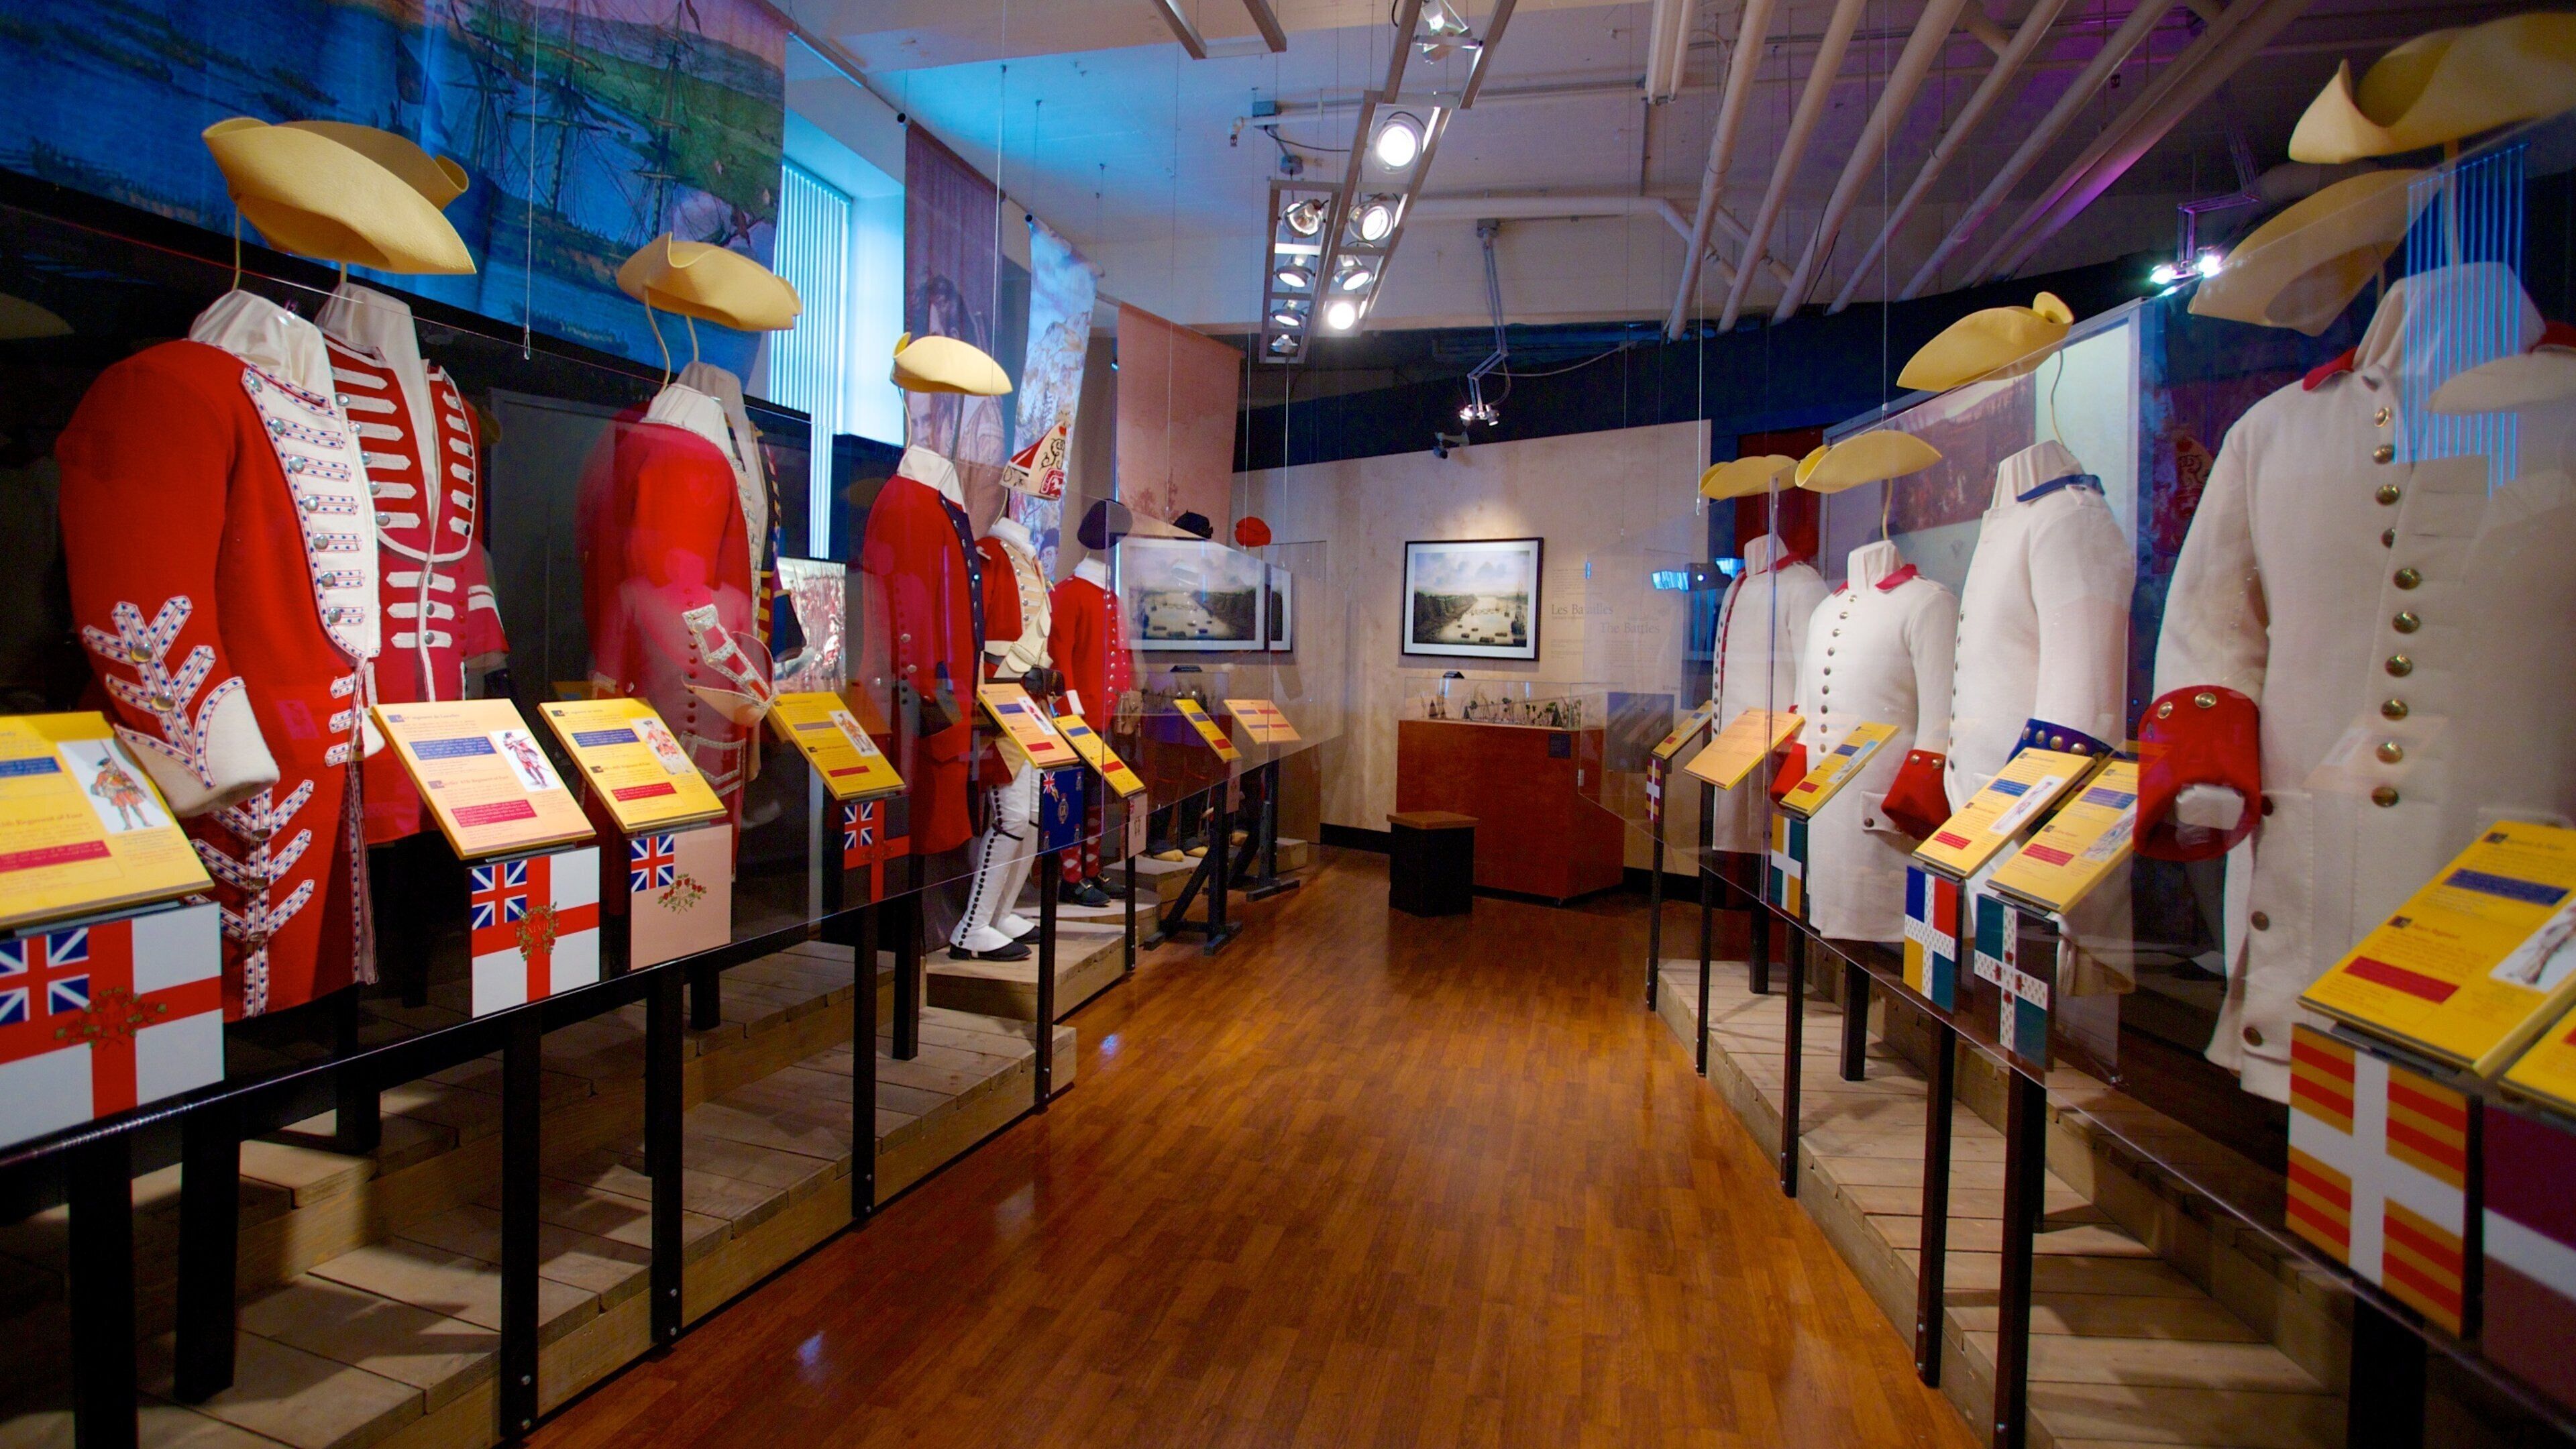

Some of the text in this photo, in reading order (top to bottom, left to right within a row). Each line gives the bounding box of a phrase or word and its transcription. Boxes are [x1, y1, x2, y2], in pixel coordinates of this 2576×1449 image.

[1551, 603, 1613, 615] Les Baailles
[1601, 622, 1660, 634] The Battles
